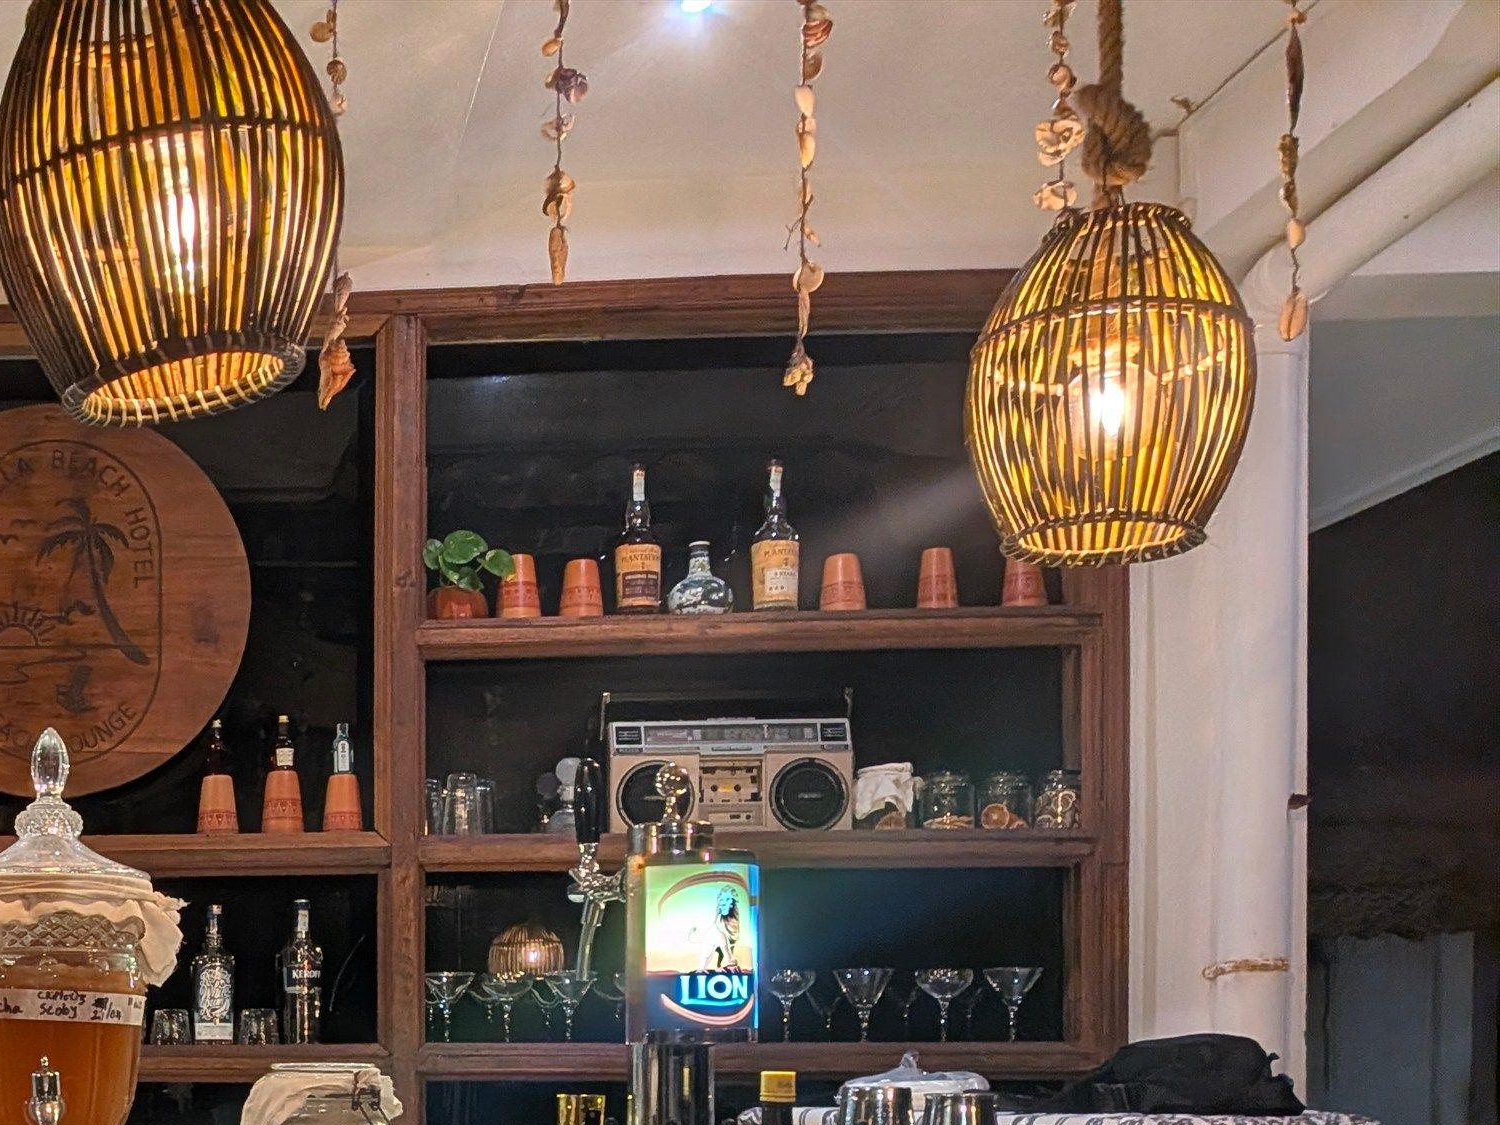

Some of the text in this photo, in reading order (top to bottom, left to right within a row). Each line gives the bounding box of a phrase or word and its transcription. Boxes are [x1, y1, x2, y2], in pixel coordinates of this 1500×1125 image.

[51, 449, 131, 498] BEACH
[124, 506, 156, 589] HOTEL
[68, 702, 138, 752] OUNGE
[680, 974, 749, 1006] LION
